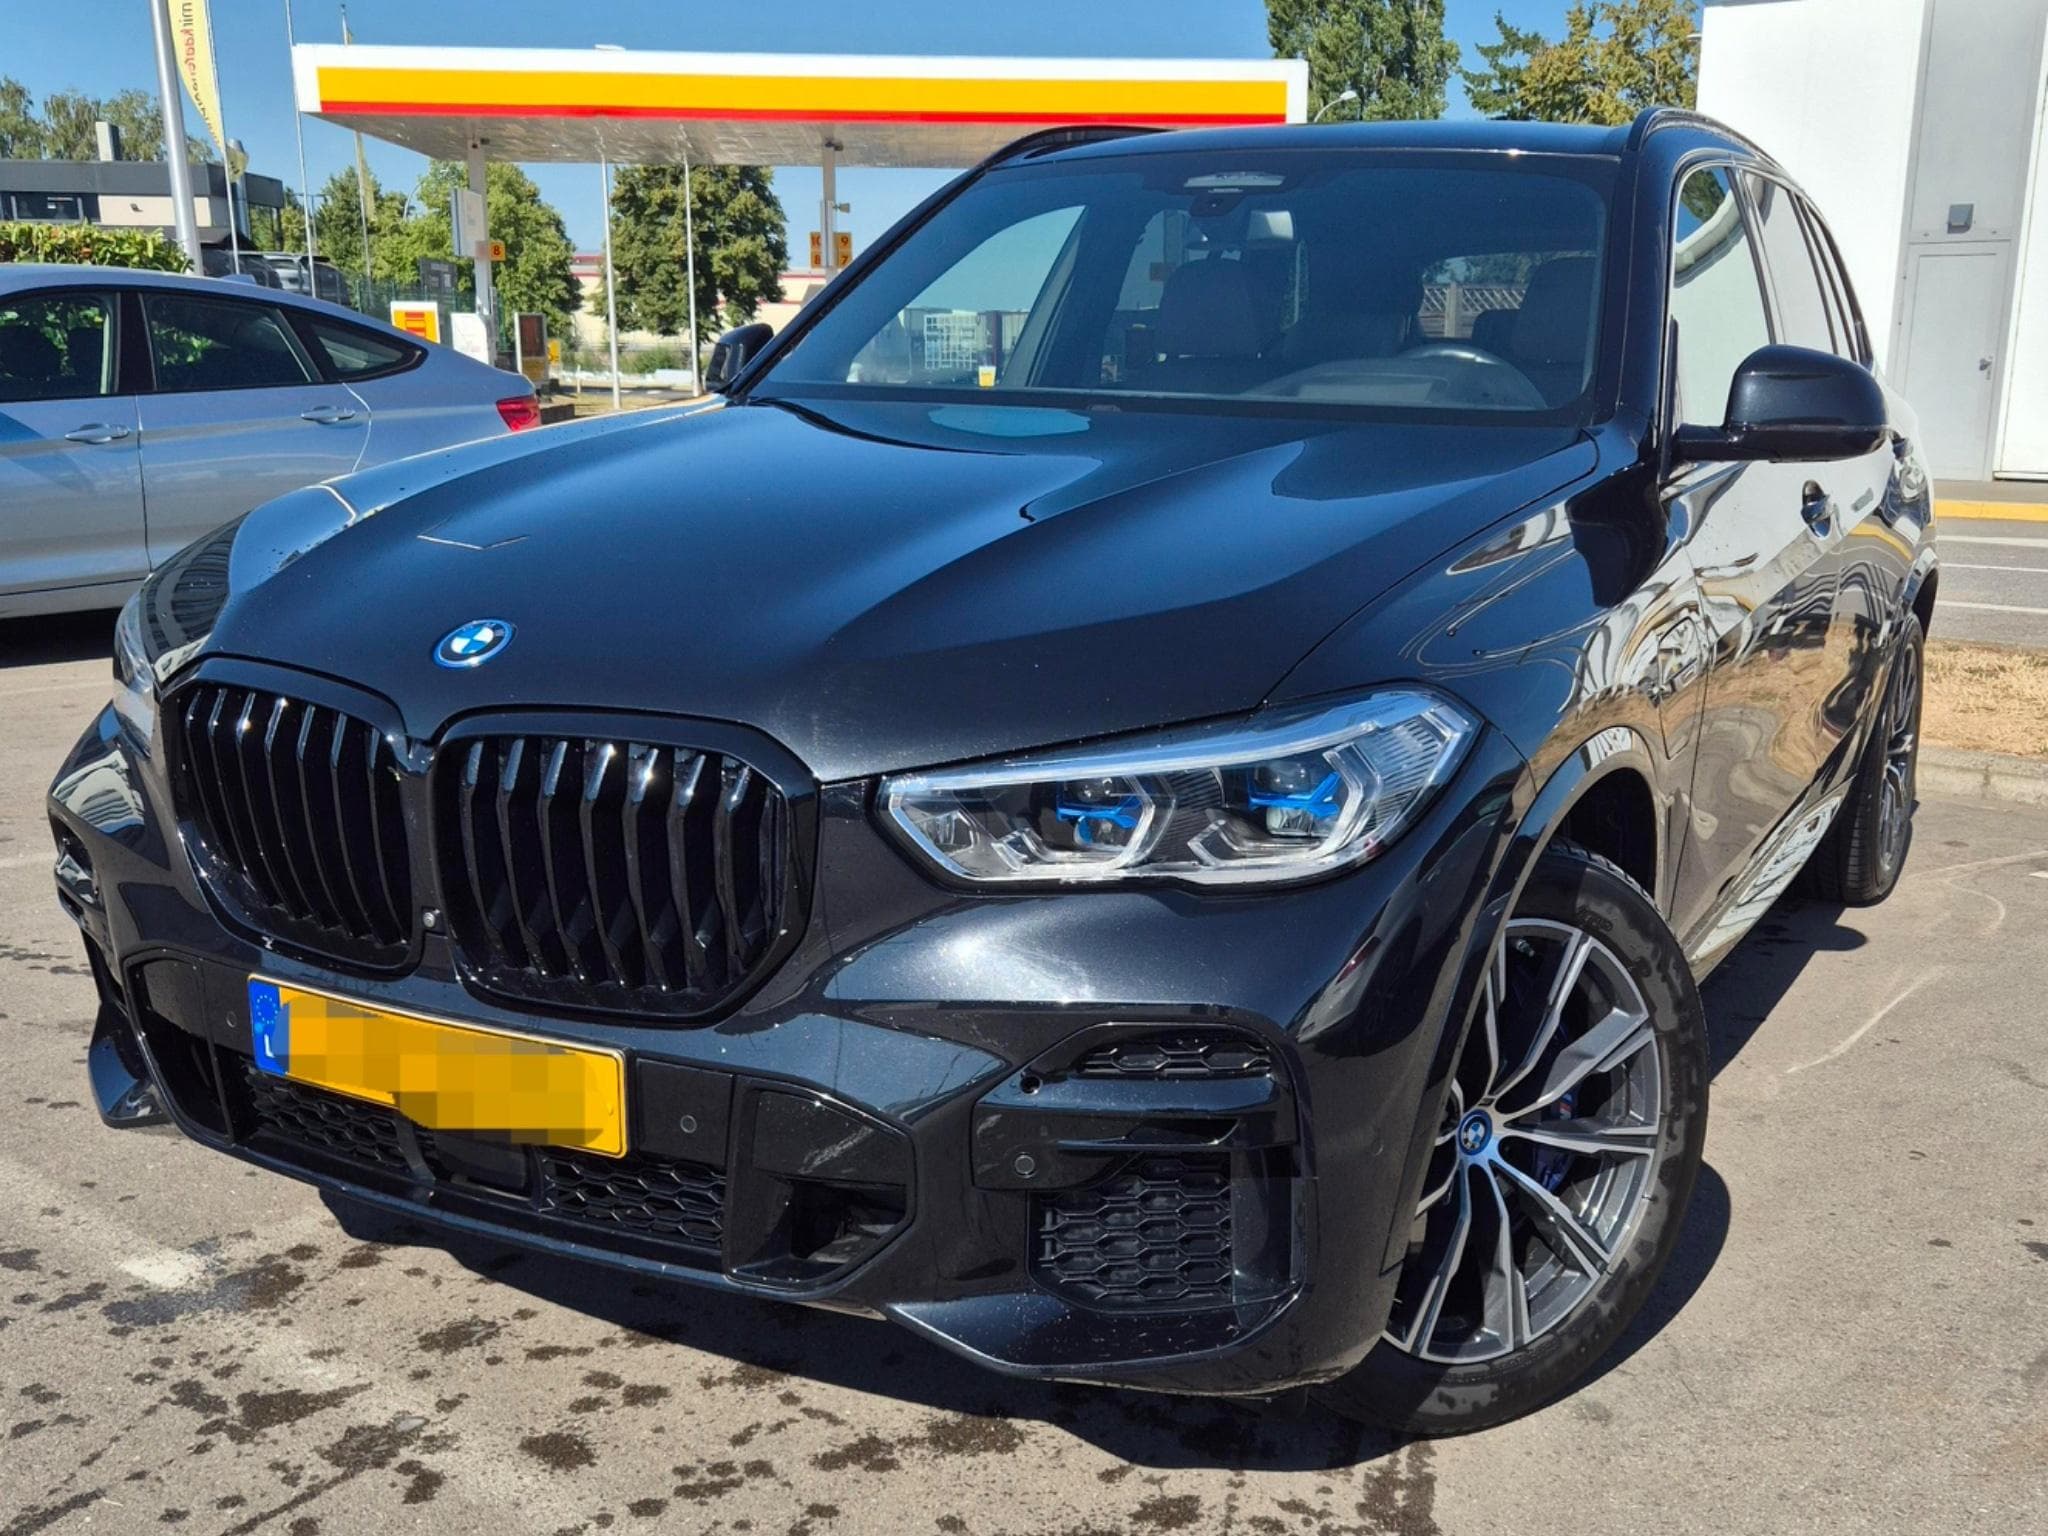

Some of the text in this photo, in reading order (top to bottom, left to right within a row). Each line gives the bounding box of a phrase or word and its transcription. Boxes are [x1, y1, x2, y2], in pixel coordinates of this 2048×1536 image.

[841, 235, 849, 246] 9
[493, 244, 501, 256] 8
[840, 255, 849, 265] 7
